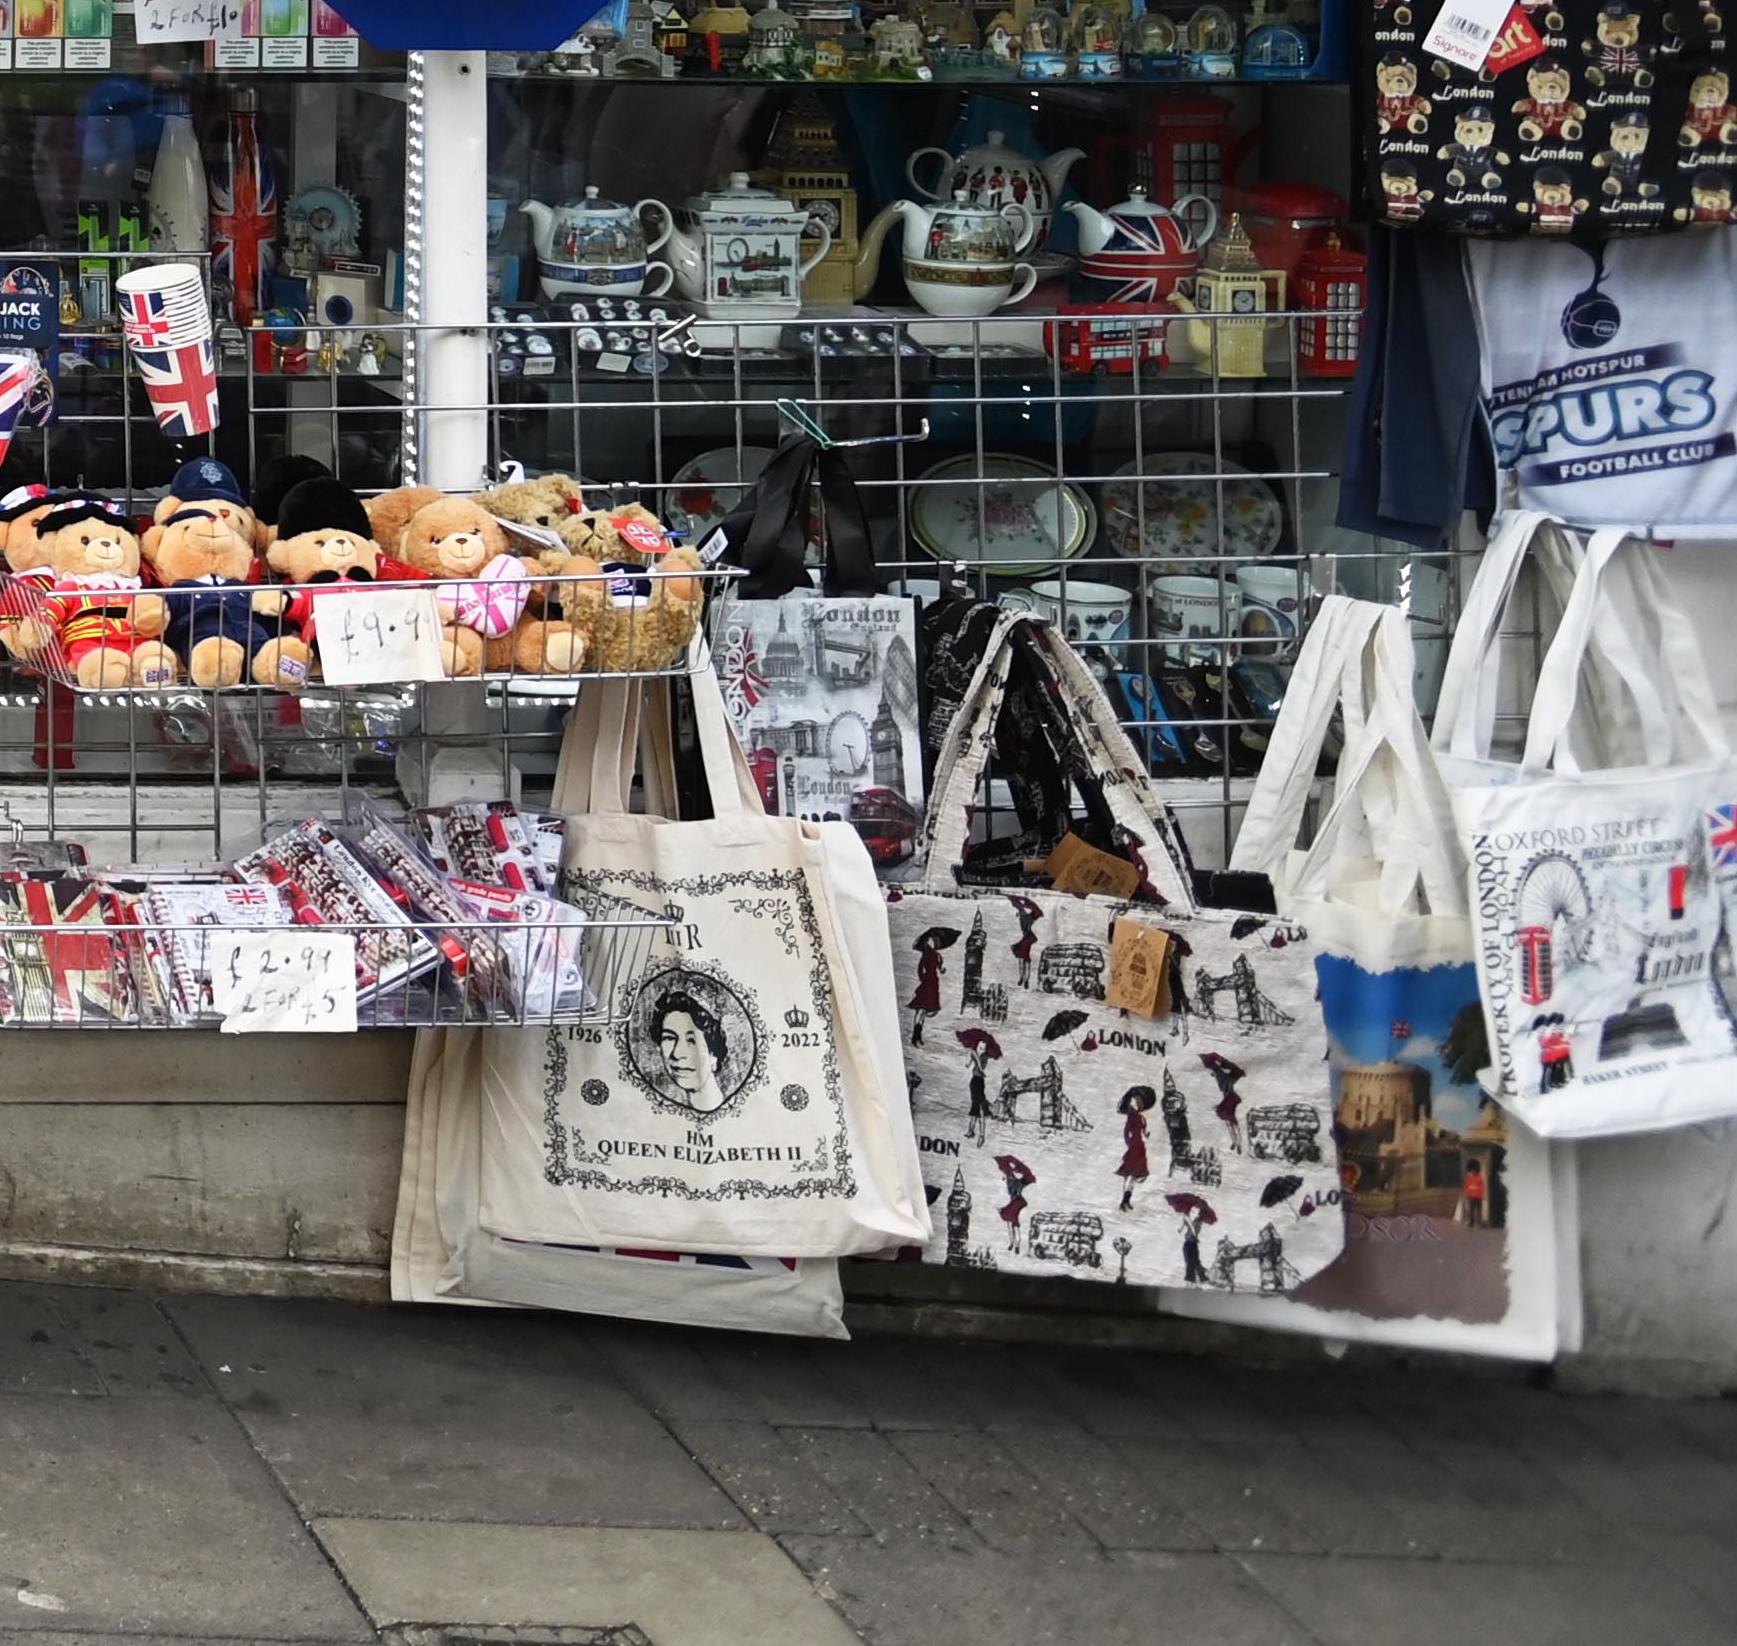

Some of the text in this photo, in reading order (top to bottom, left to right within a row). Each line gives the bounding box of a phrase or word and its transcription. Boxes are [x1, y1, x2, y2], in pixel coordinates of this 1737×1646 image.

[1432, 34, 1478, 62] Signare
[1432, 85, 1652, 108] London London
[1520, 146, 1584, 163] London
[1444, 189, 1665, 214] London London
[0, 300, 41, 317] JACK
[1561, 355, 1646, 381] HOTSPUR
[1489, 368, 1717, 464] SPURS
[1559, 450, 1665, 479] FOOTBALL
[1494, 826, 1586, 852] OXFORD
[1472, 833, 1499, 935] LONDON
[566, 1026, 821, 1049] 1926 2022
[596, 1138, 802, 1166] QUEEN ELIZABETH II
[686, 1131, 714, 1149] HM
